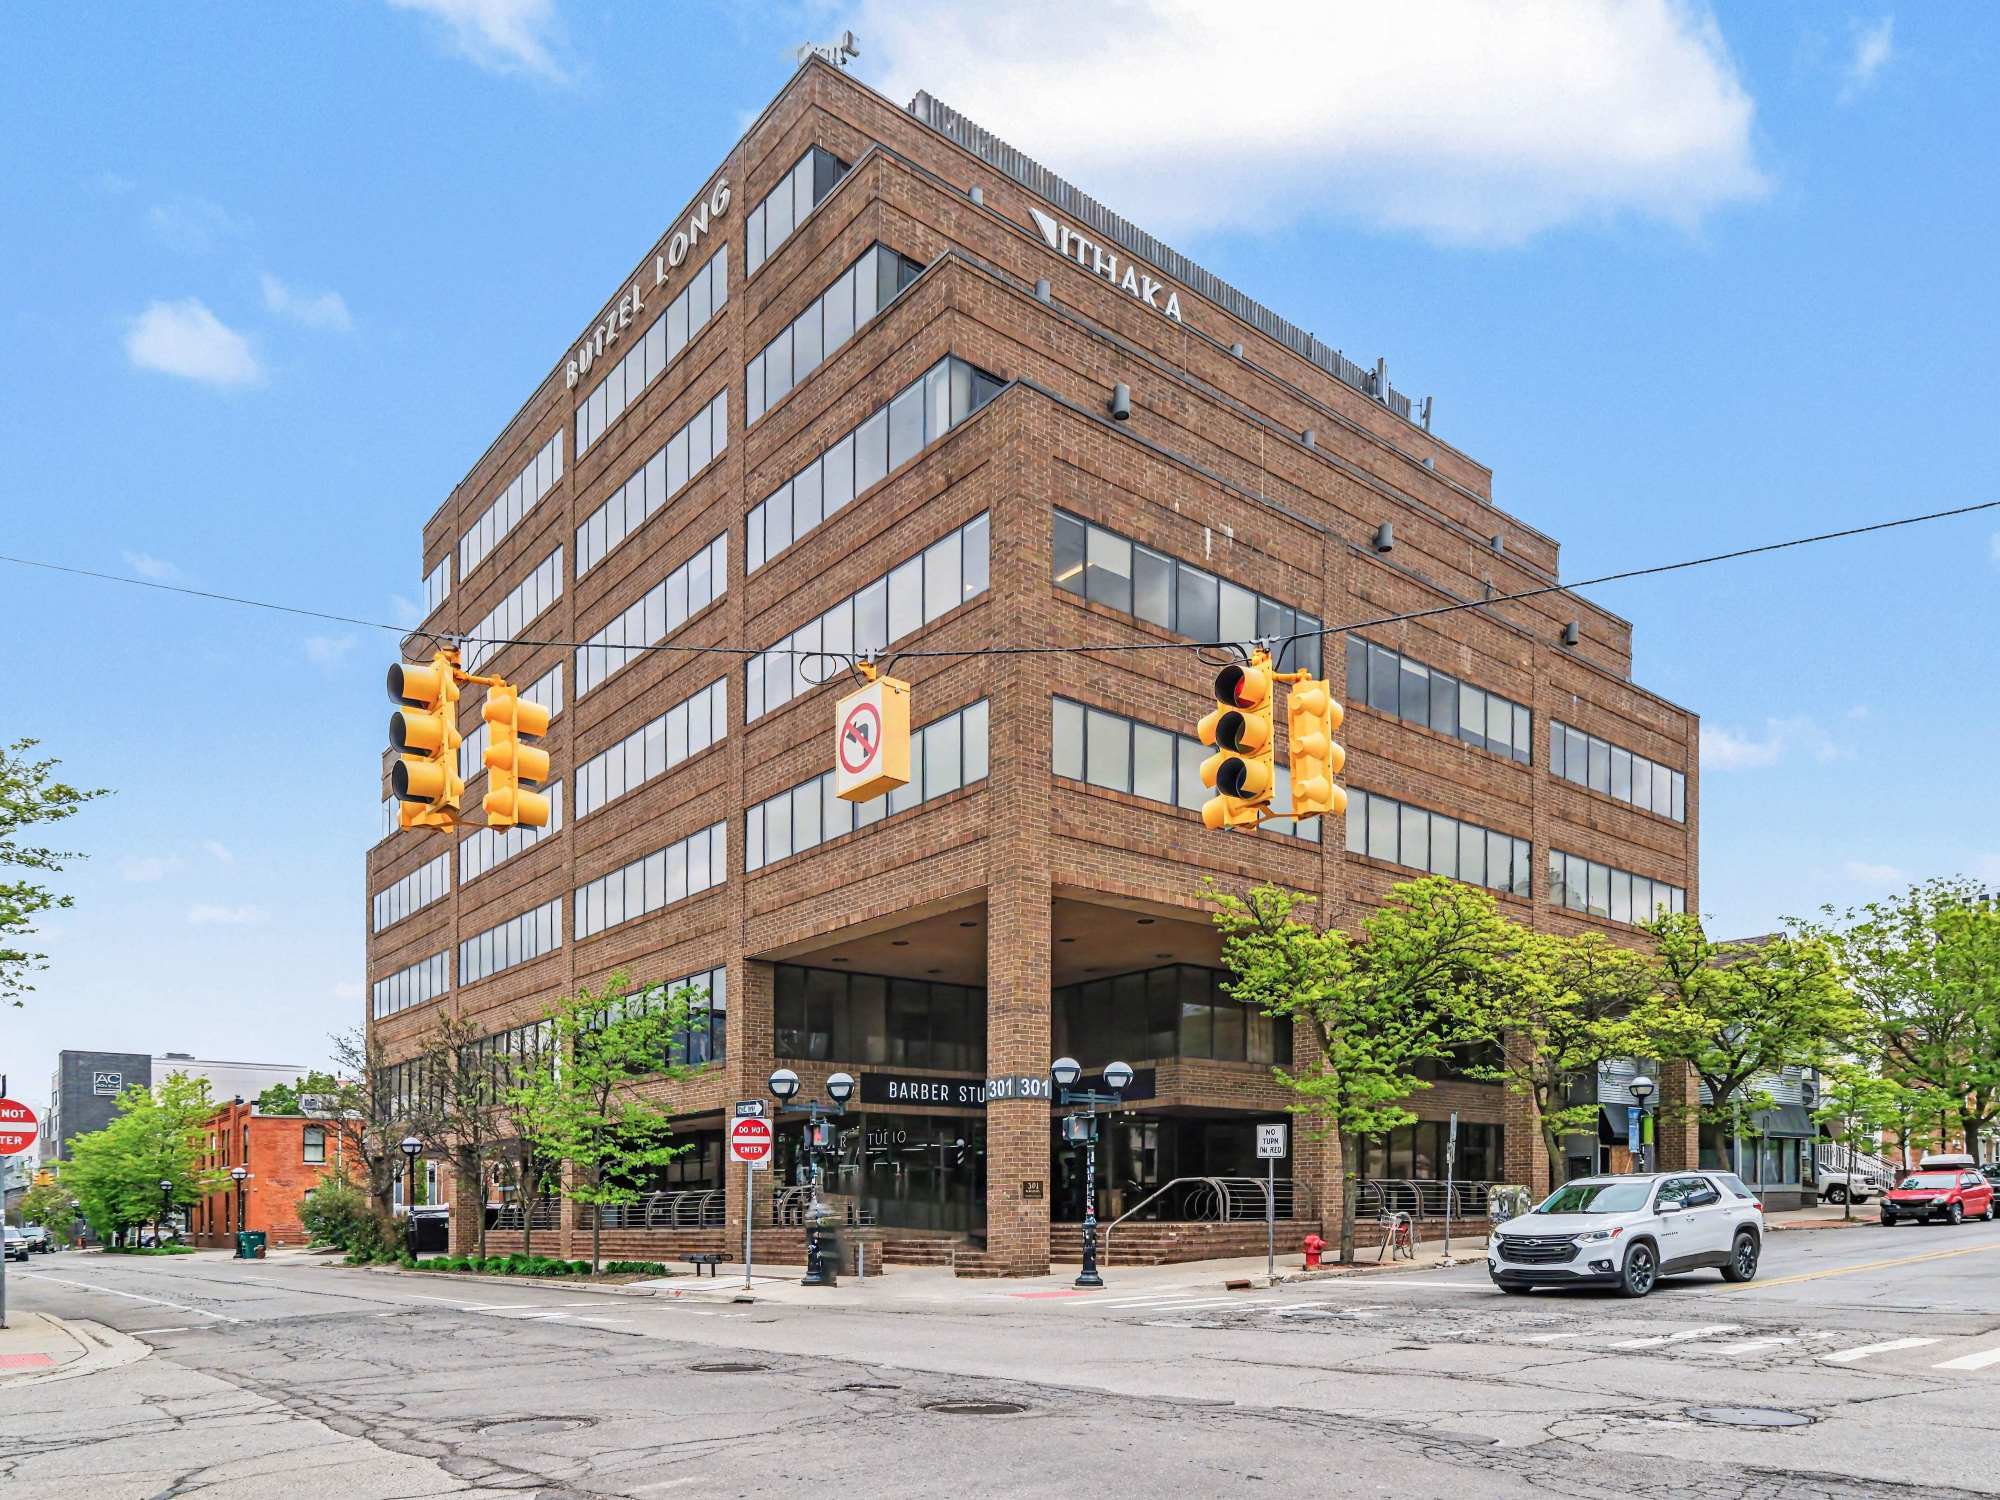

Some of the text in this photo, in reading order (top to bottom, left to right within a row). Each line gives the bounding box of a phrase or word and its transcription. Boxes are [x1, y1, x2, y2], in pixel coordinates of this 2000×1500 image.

[1059, 224, 1182, 323] ITHAKA
[566, 178, 731, 390] BUTZEL LONG
[96, 1074, 120, 1084] AC
[989, 1078, 1012, 1098] 301
[1021, 1078, 1049, 1097] 301
[889, 1081, 986, 1103] BARBER STU
[2, 1109, 26, 1118] NOT
[0, 1136, 23, 1145] TER
